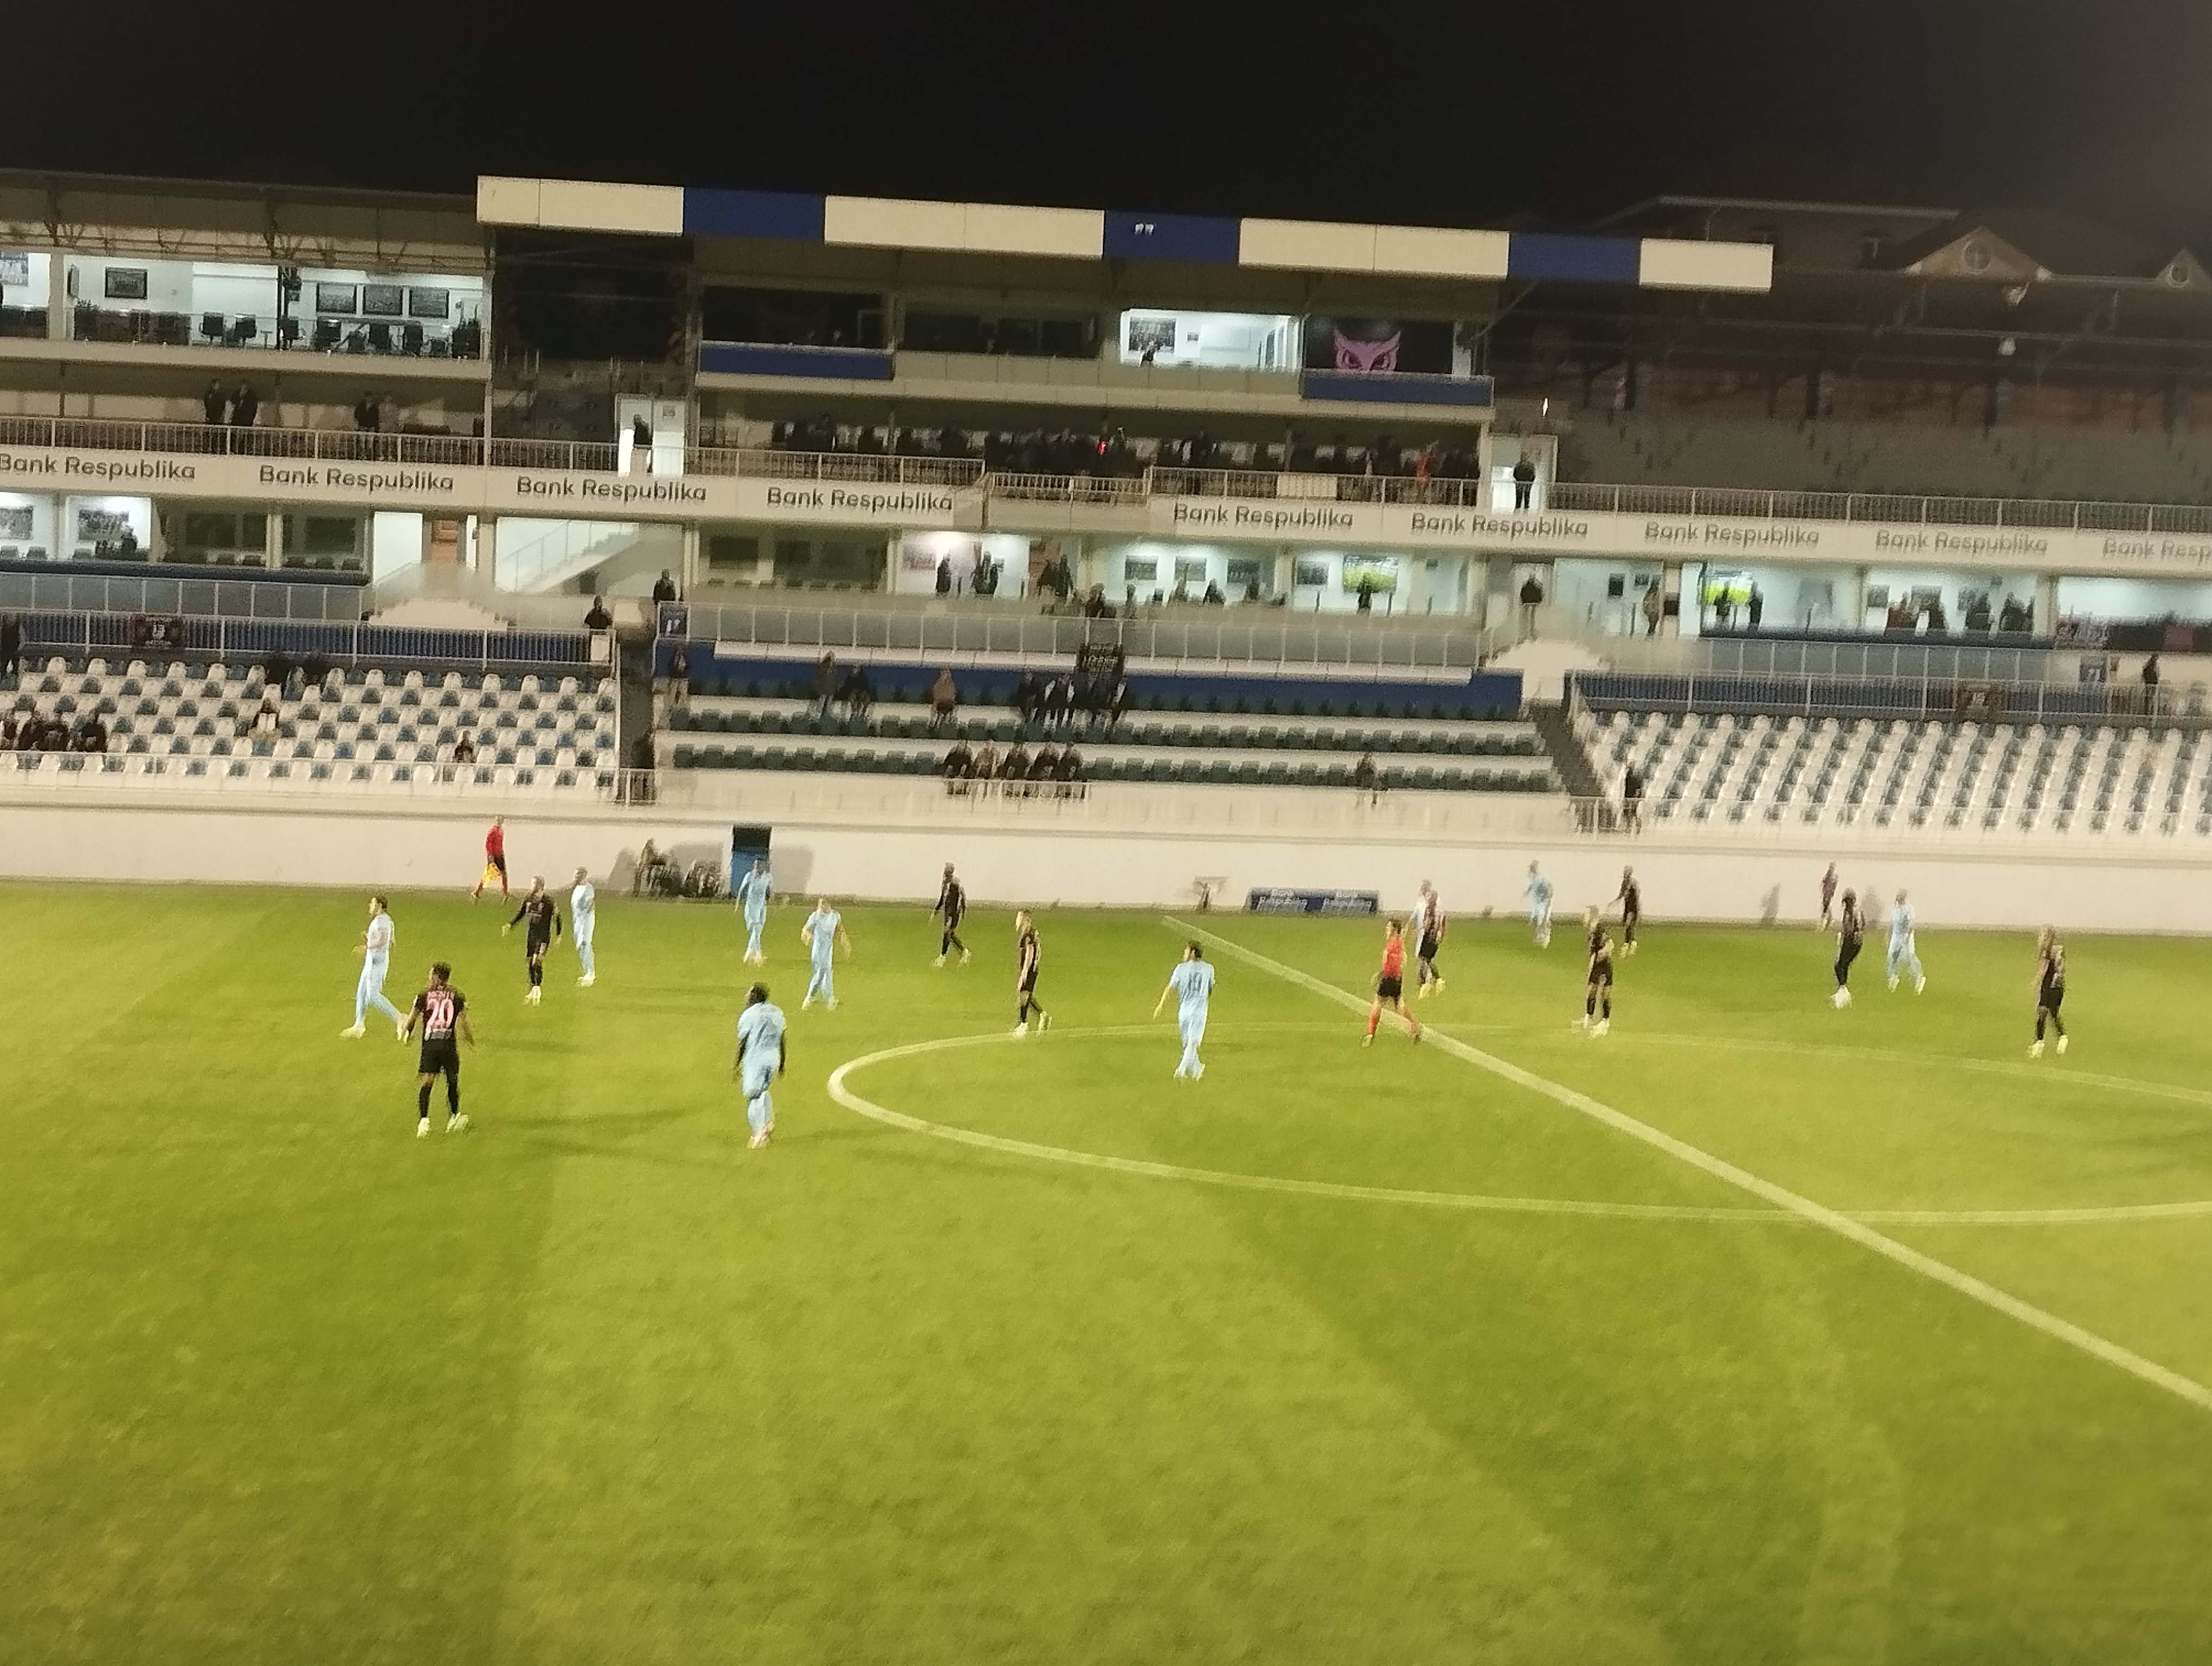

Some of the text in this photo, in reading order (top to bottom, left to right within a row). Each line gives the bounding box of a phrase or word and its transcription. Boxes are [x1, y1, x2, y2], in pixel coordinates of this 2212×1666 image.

[0, 453, 196, 482] Bank Respublika
[259, 464, 454, 494] Bank Respublika
[517, 475, 707, 503] Bank Respublika
[766, 486, 953, 513] Bank Respublika
[1173, 502, 1354, 530] Bank Respublika
[1411, 512, 1588, 541] Bank Respublika
[1644, 521, 1819, 549] Bank Respublika
[1875, 529, 2048, 556] Bank Respublika
[2102, 537, 2155, 559] Bank
[426, 998, 454, 1030] 20
